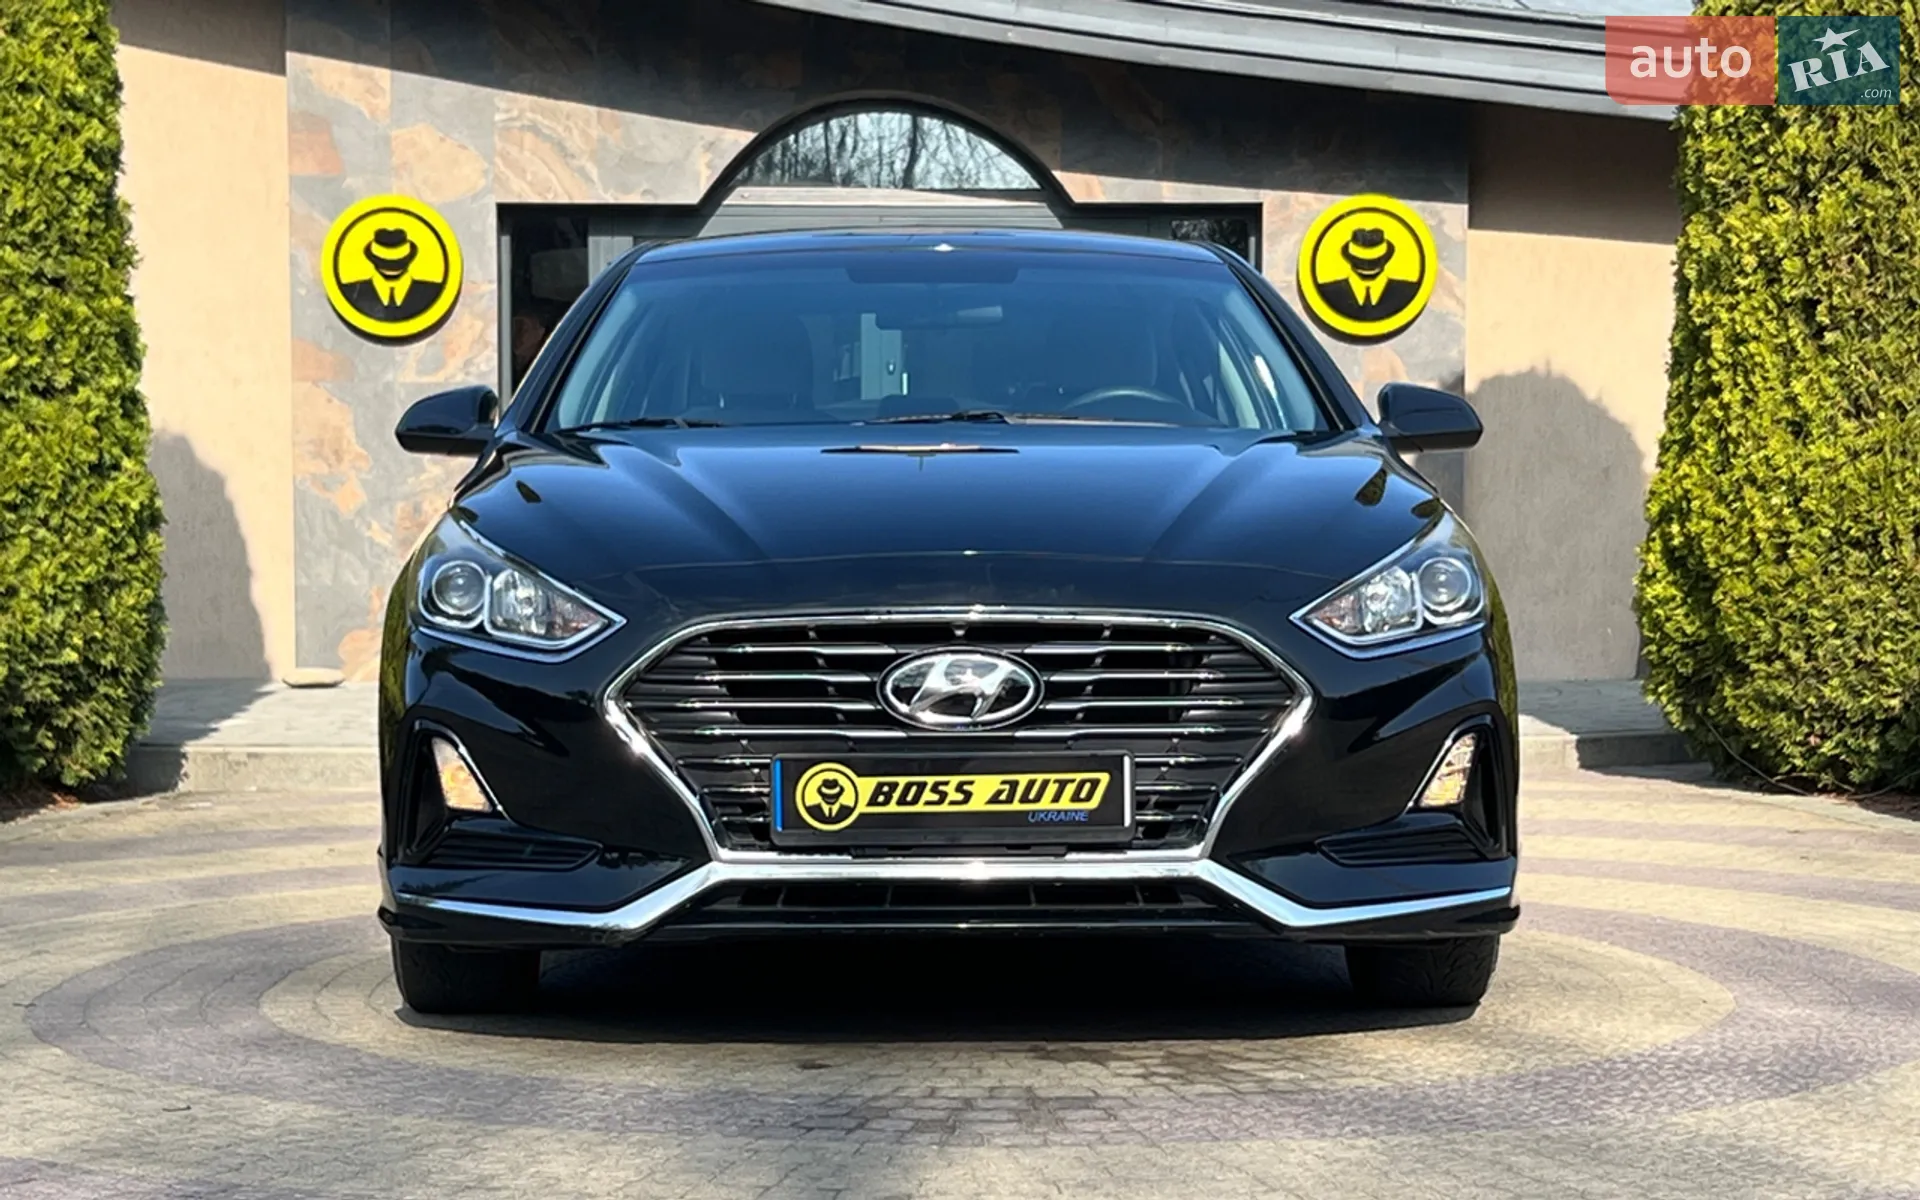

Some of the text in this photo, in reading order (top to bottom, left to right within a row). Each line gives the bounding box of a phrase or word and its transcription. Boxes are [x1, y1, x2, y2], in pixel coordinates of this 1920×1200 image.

[866, 778, 1101, 807] BOSS AUTO
[1028, 810, 1089, 823] UKRAINE
